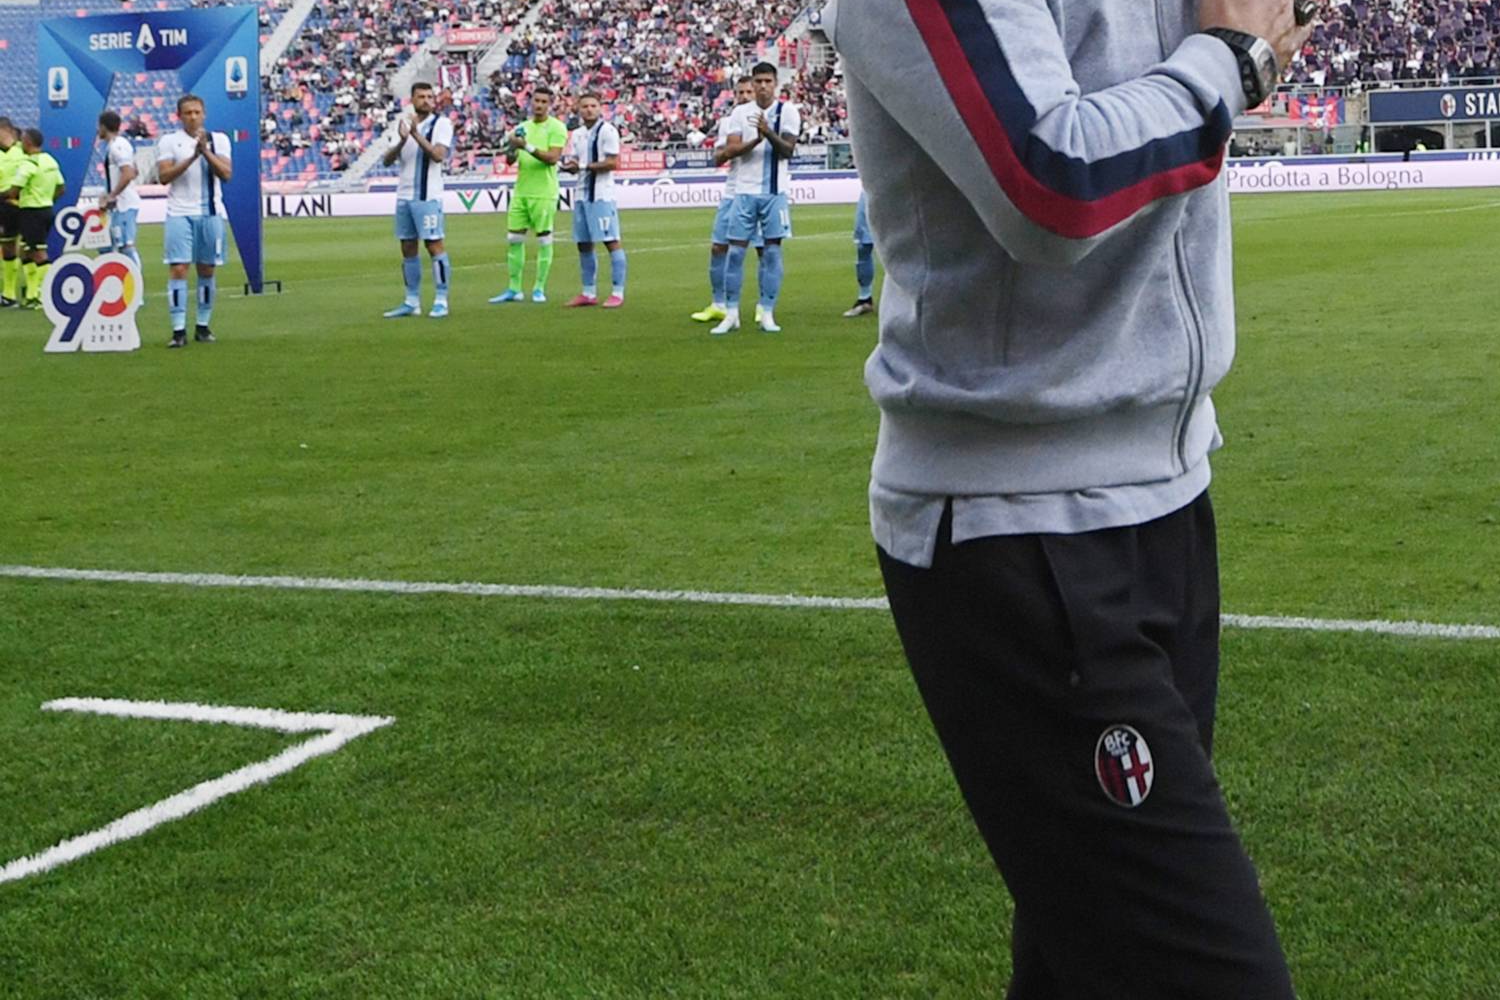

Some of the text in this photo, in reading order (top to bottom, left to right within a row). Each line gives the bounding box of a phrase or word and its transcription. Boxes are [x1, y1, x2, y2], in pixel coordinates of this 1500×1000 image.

[89, 32, 133, 50] SERIE
[159, 29, 187, 46] TIM
[1226, 164, 1424, 190] Prodotta a Bologna
[266, 195, 332, 216] LLANI
[652, 186, 722, 204] Prodotta
[423, 215, 438, 229] 33
[598, 216, 610, 231] 17
[51, 261, 136, 342] 90
[1104, 730, 1130, 752] BFC
